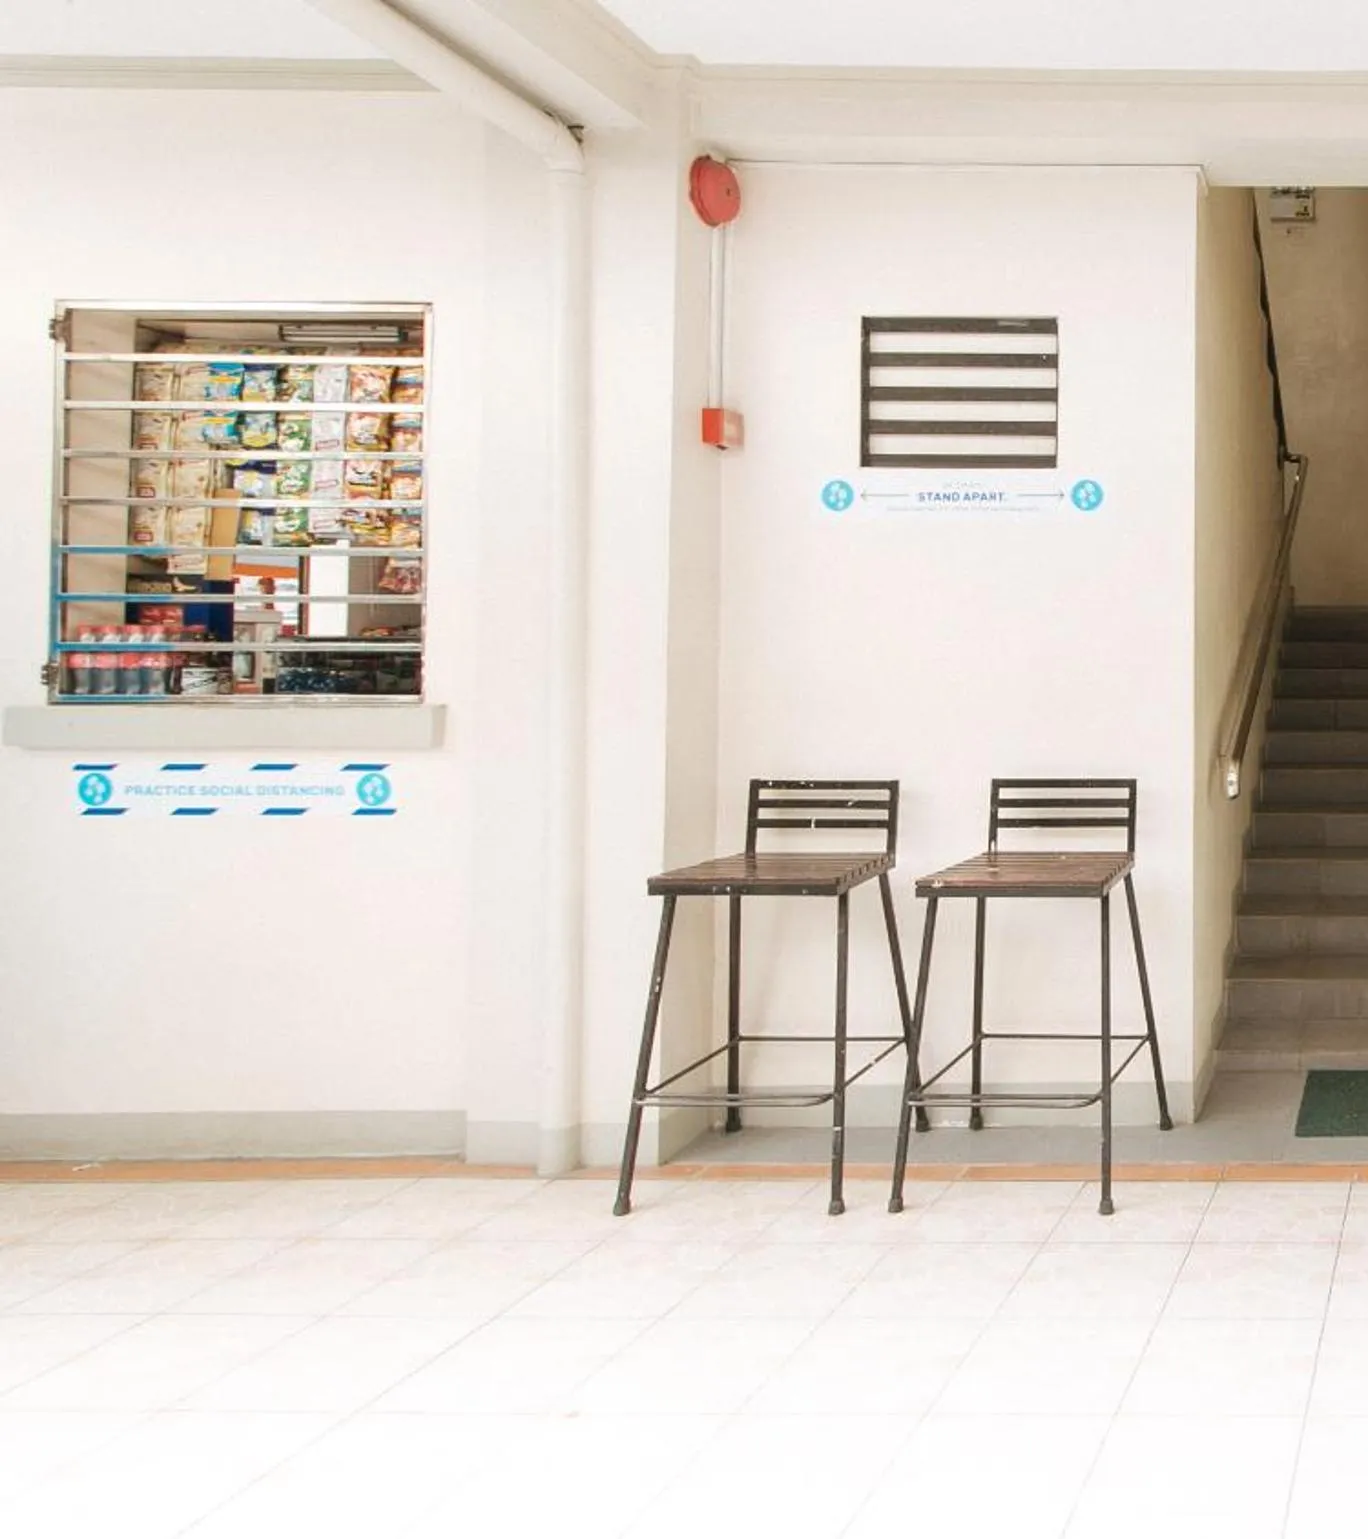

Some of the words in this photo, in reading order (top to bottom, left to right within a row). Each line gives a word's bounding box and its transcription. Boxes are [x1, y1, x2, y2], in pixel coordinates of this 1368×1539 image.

[918, 491, 960, 503] STAND
[124, 784, 196, 797] PRACTICE
[199, 784, 253, 797] SOCIAL
[256, 784, 345, 797] DISTANCING
